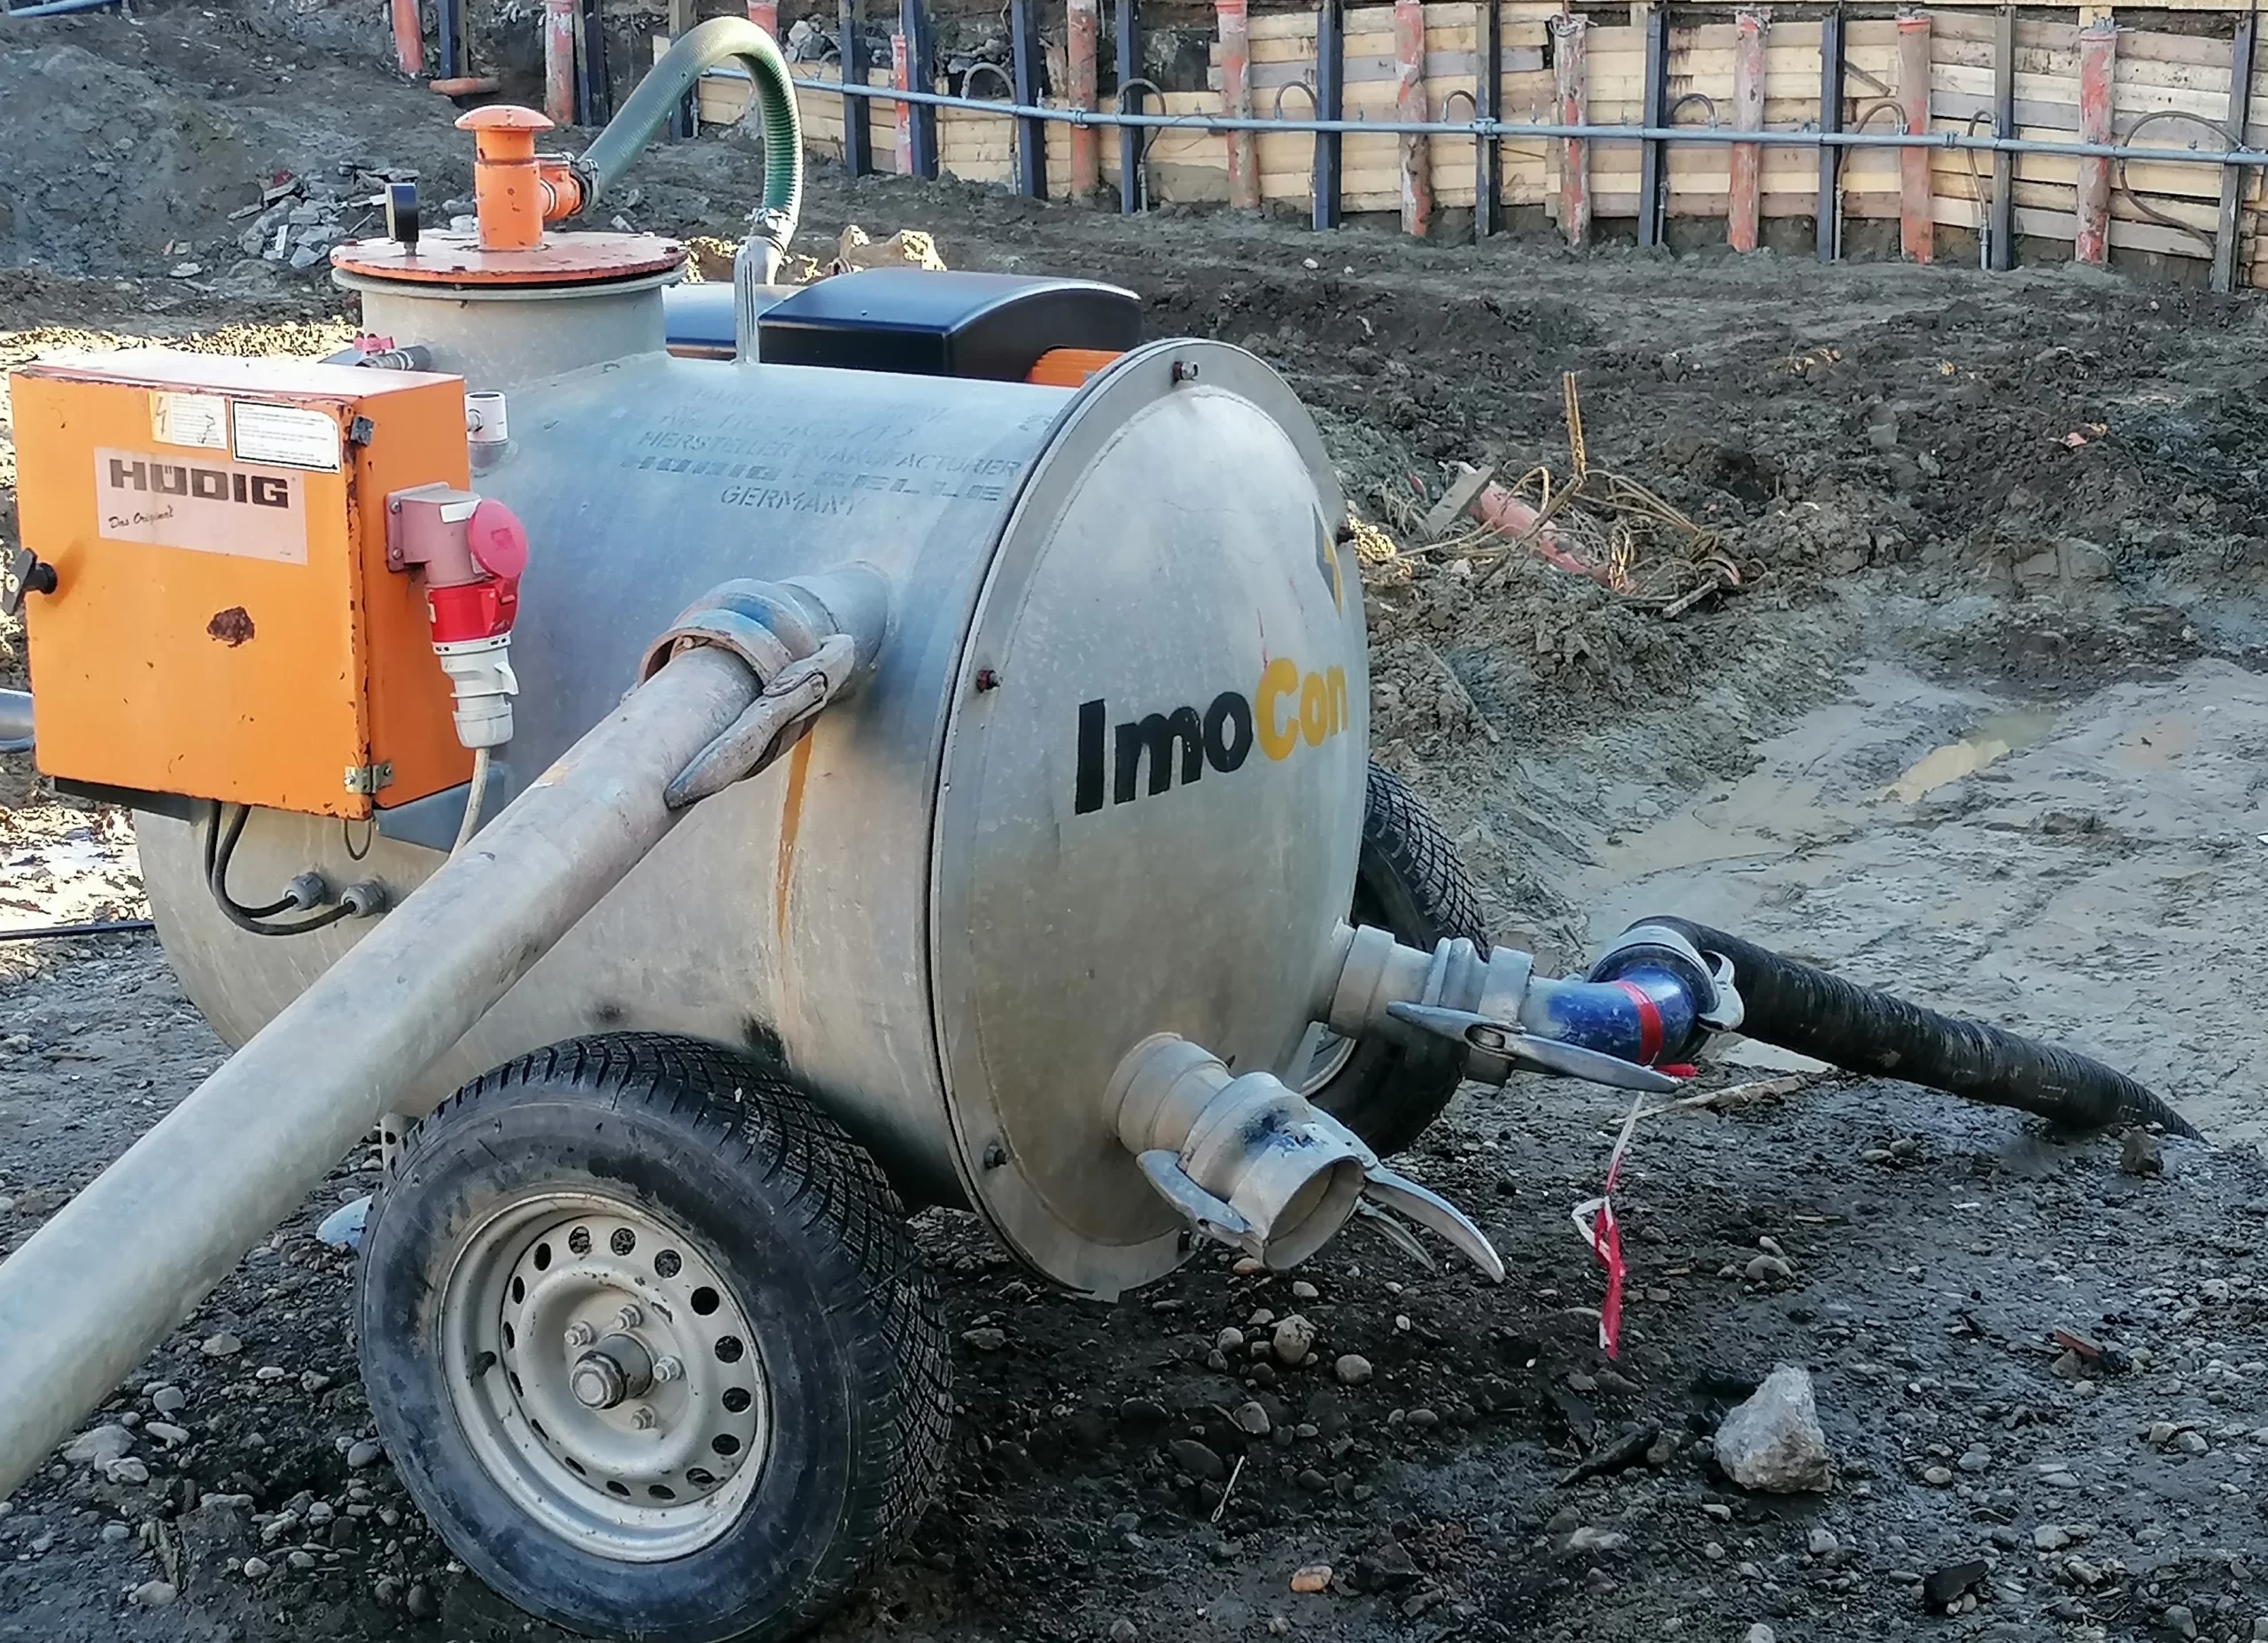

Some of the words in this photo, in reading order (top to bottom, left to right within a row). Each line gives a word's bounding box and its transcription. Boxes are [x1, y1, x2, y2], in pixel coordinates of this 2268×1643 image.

[110, 458, 289, 508] HÜDIG
[720, 485, 866, 515] GERMANY
[108, 515, 129, 529] Das
[133, 504, 174, 526] Original
[1075, 657, 1348, 815] ImoCon
